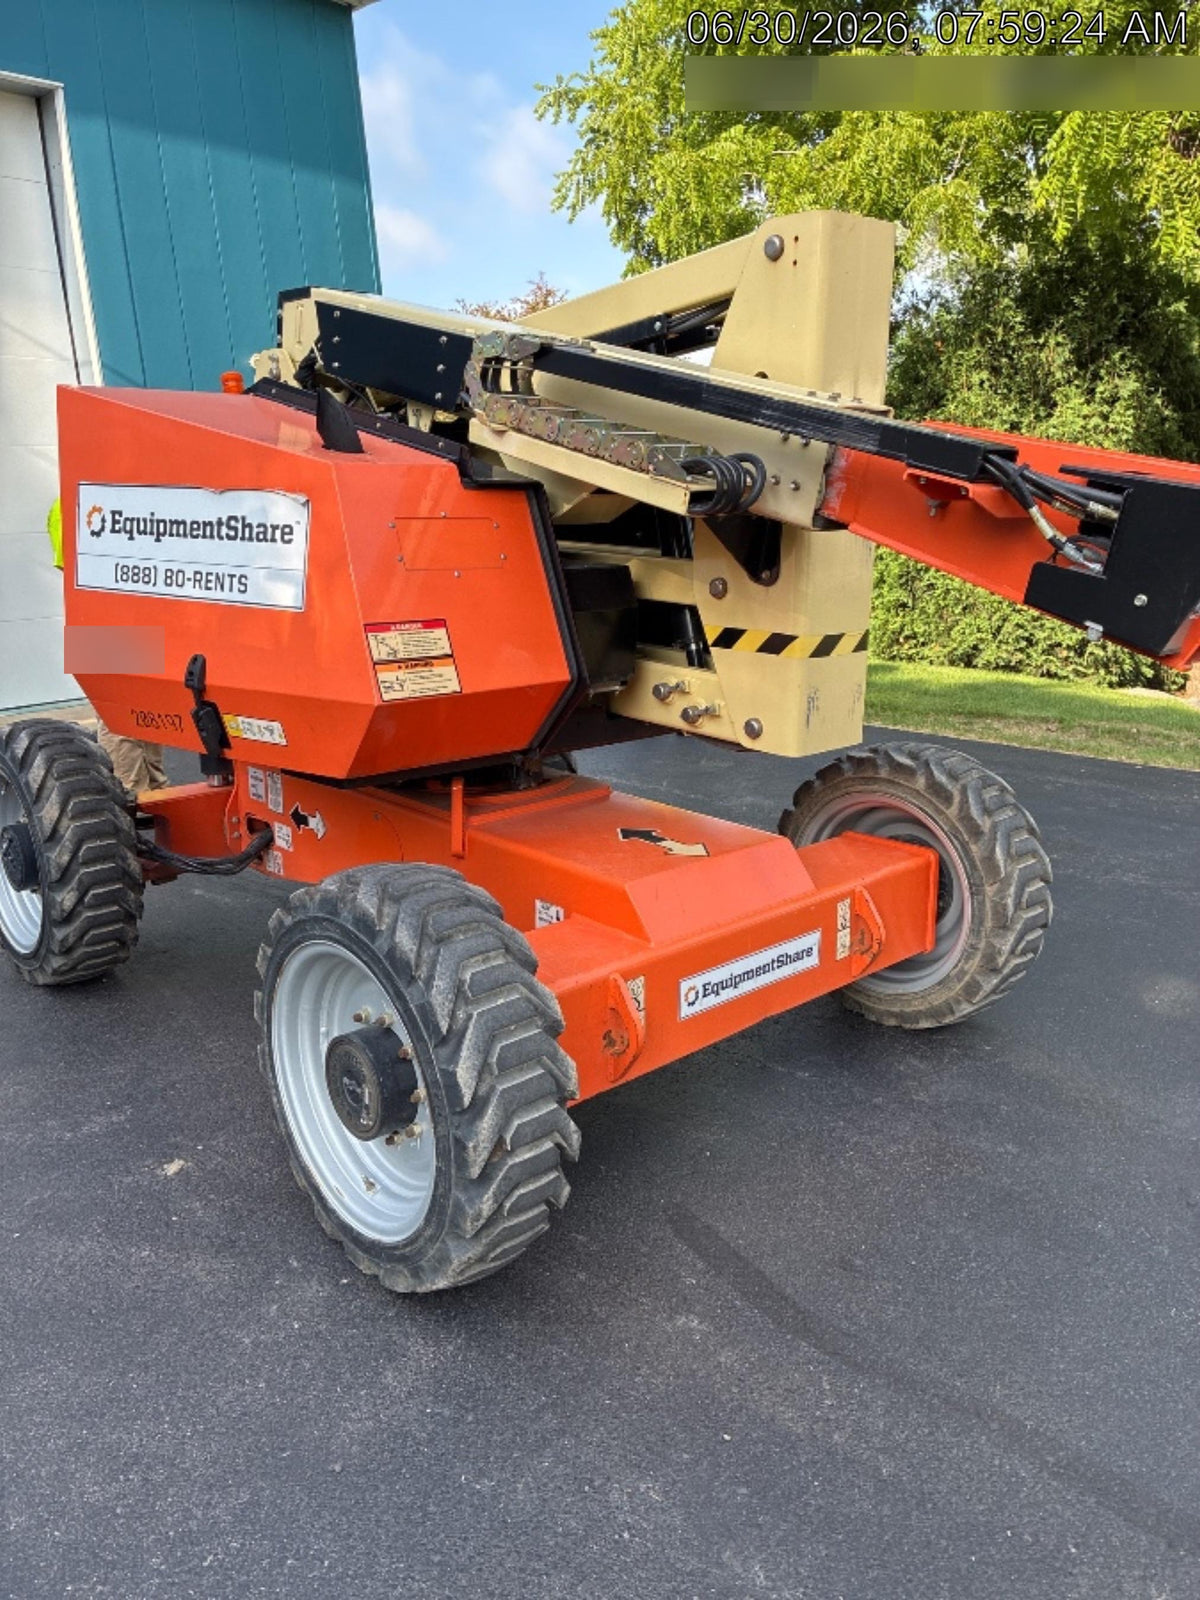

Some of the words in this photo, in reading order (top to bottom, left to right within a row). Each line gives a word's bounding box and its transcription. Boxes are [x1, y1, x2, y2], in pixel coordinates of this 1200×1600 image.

[109, 510, 294, 545] EquipmentShare
[114, 562, 157, 587] (888)
[164, 568, 248, 594] 80-RENTS
[702, 946, 813, 998] EquipmentShare
